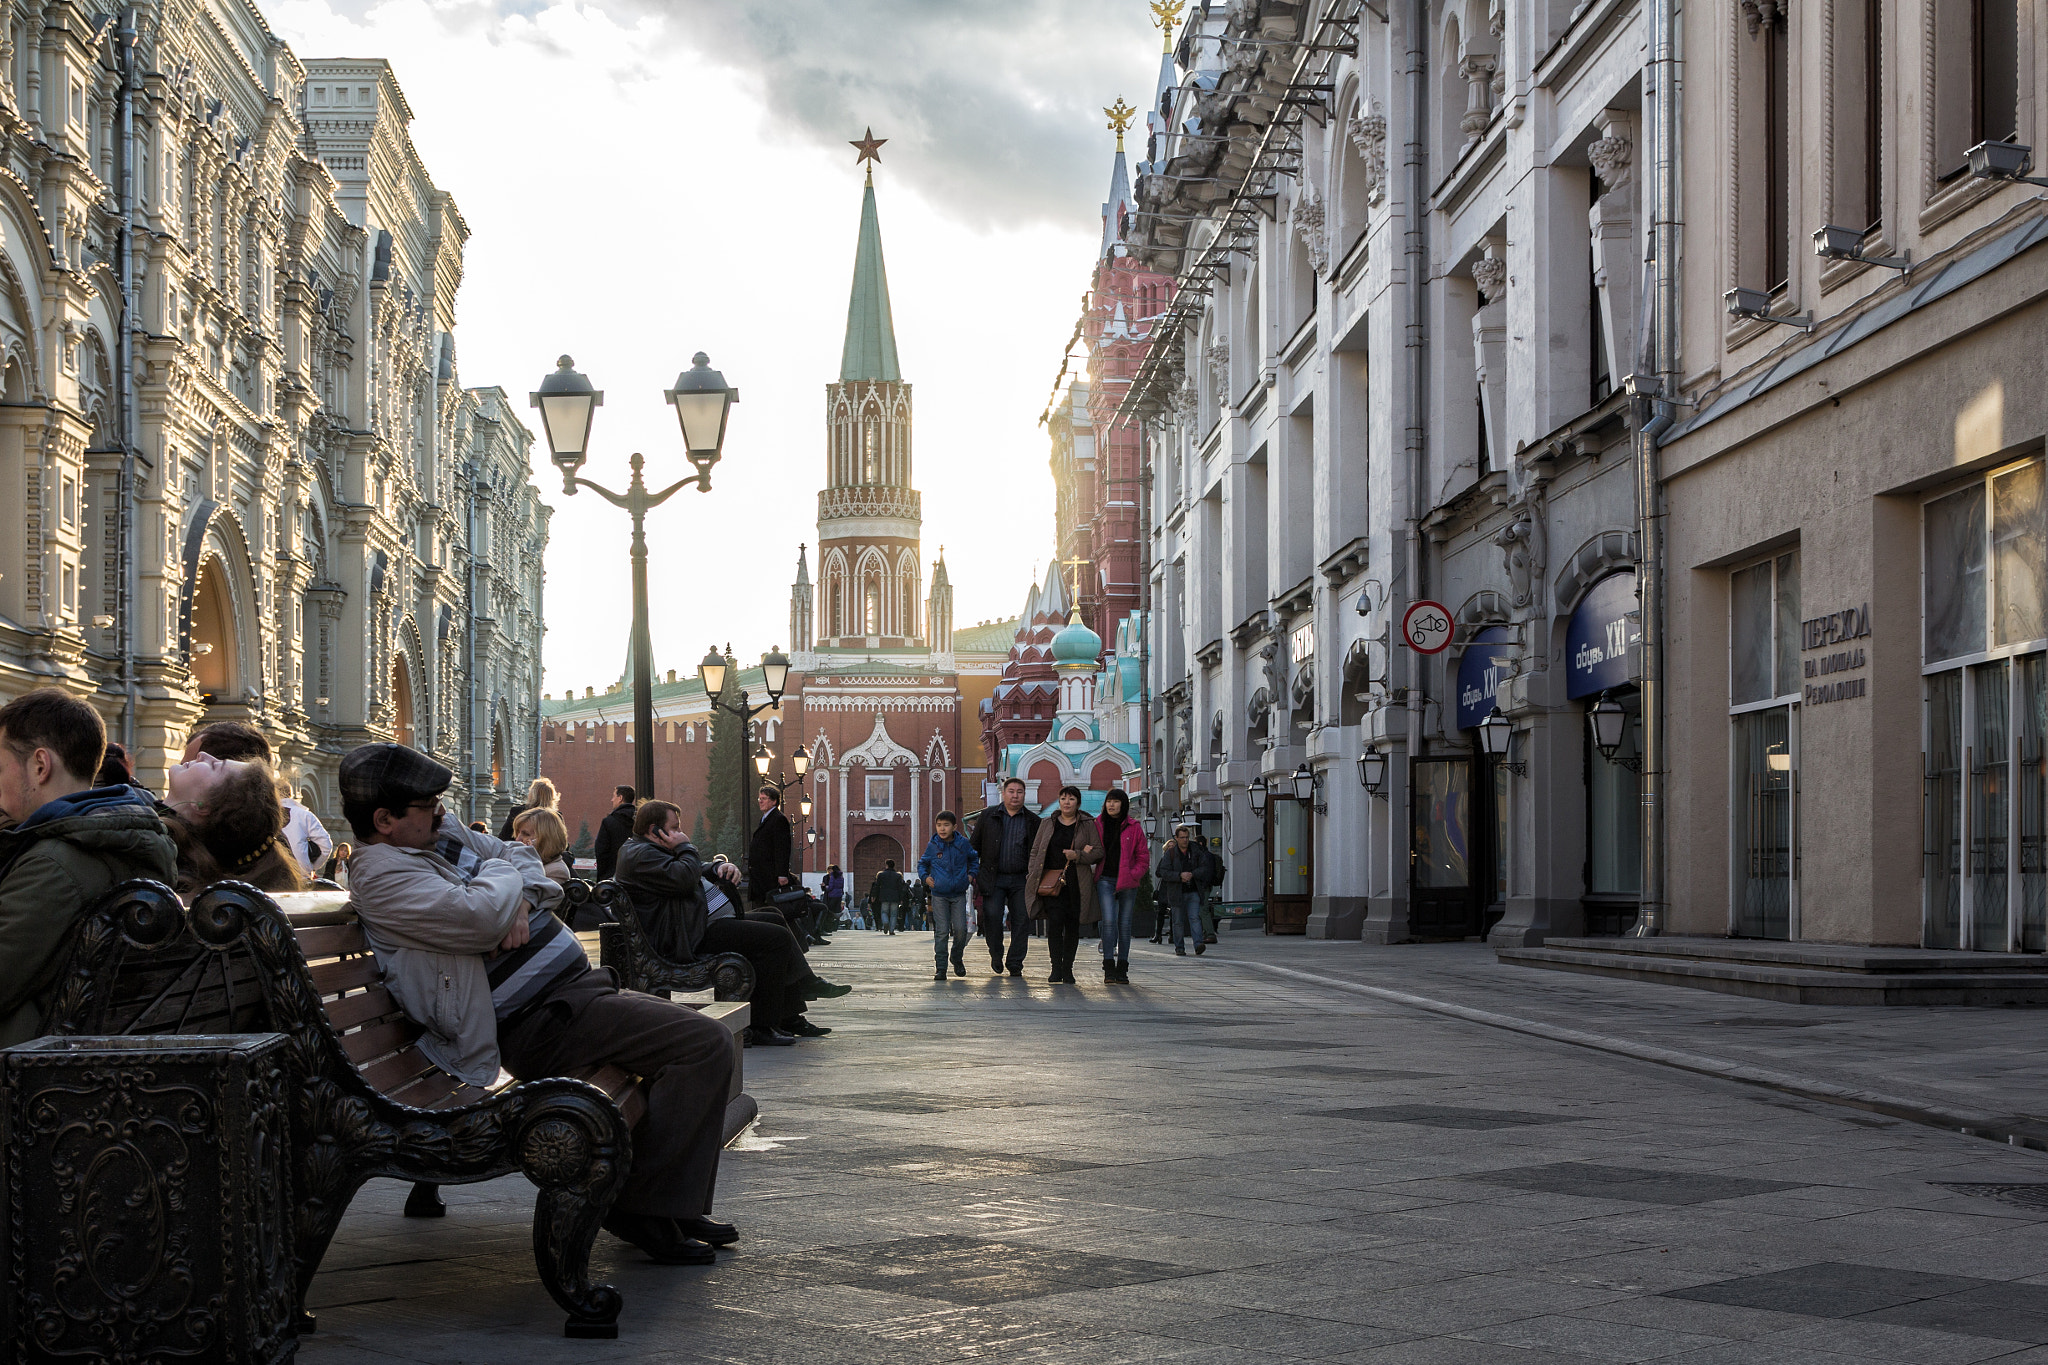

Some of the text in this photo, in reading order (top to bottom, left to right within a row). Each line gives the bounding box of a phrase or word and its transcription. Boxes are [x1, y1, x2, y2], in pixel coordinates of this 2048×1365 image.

[1291, 623, 1314, 664] ОБУВЬ
[1576, 618, 1625, 674] обувь XXI
[1801, 602, 1871, 651] ПЕРЕХОД
[1804, 648, 1865, 678] НА ПЛОЩАДЬ
[1462, 665, 1498, 711] обувь XXI
